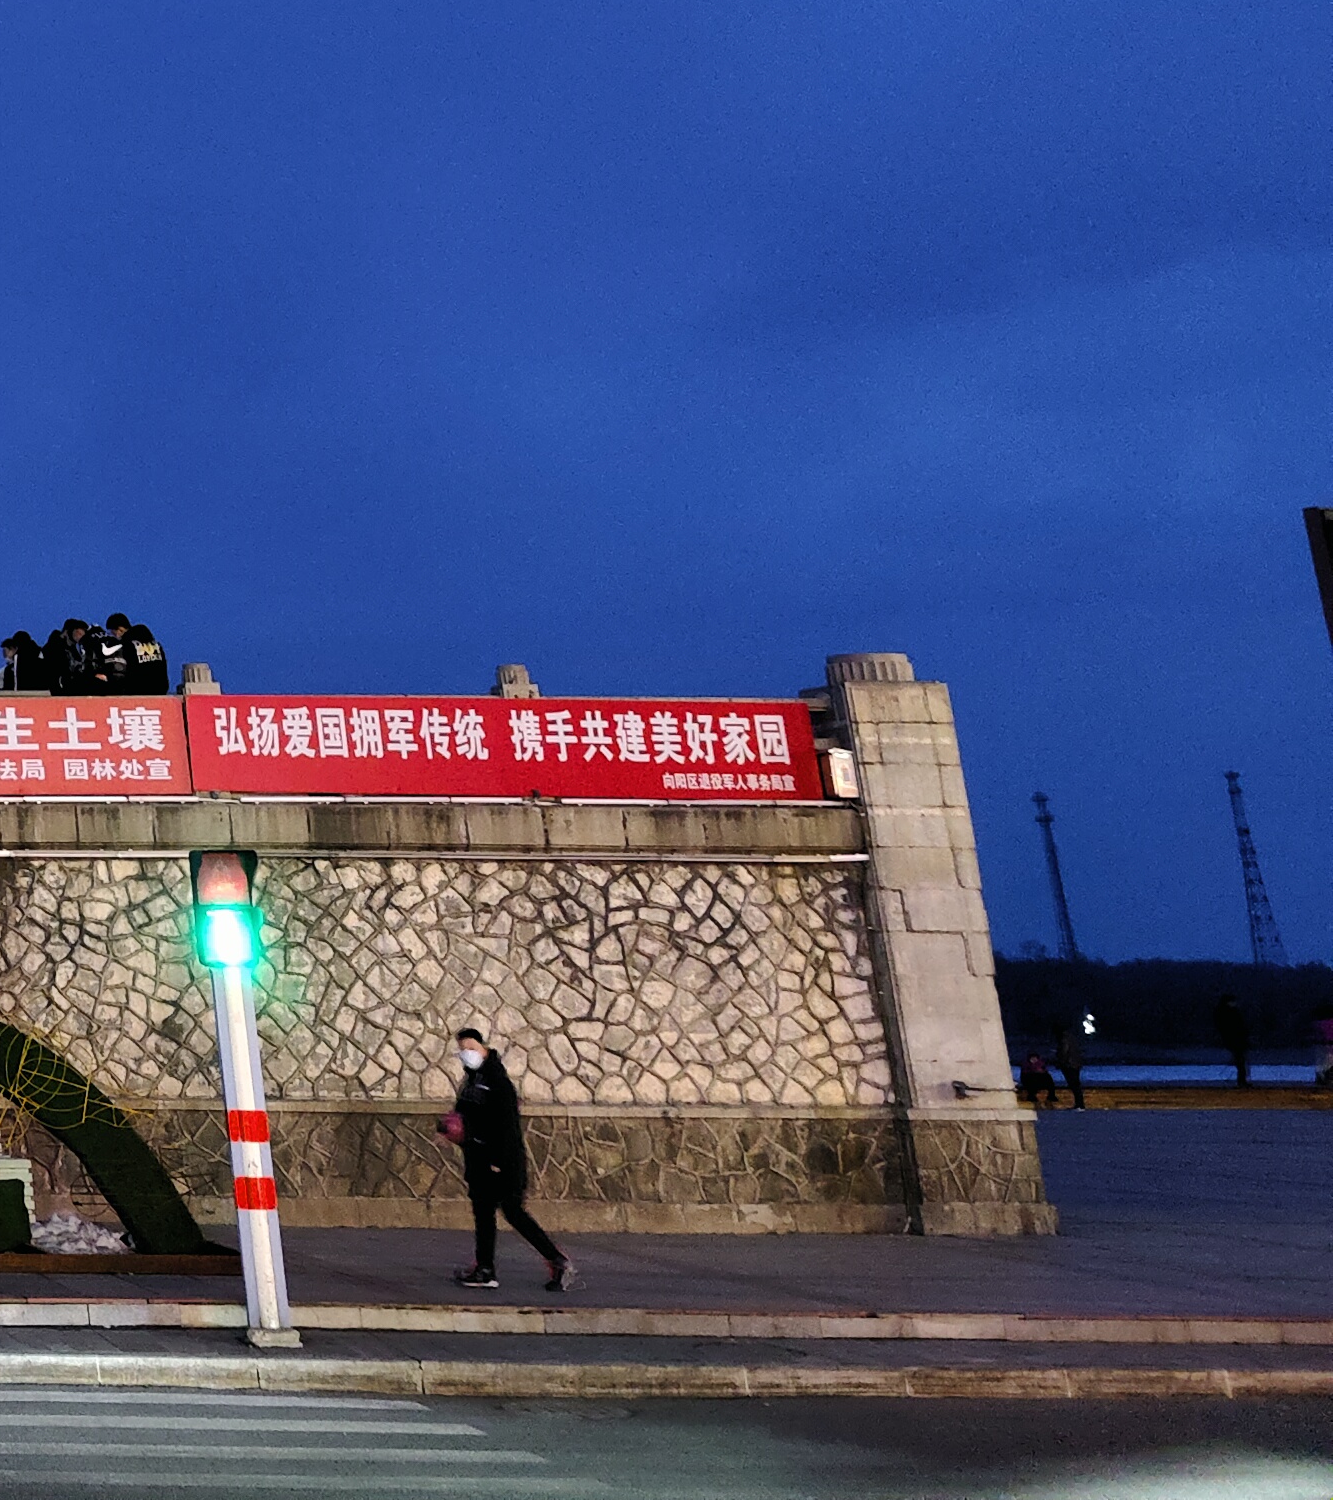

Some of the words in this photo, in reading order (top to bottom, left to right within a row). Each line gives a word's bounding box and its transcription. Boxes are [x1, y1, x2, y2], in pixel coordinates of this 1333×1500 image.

[213, 706, 489, 760] 弘扬爱国拥军传统
[508, 709, 791, 765] 携手共建美好家园
[63, 758, 173, 782] 园林处宣
[662, 772, 796, 791] 向阳区退役军人事务局宣
